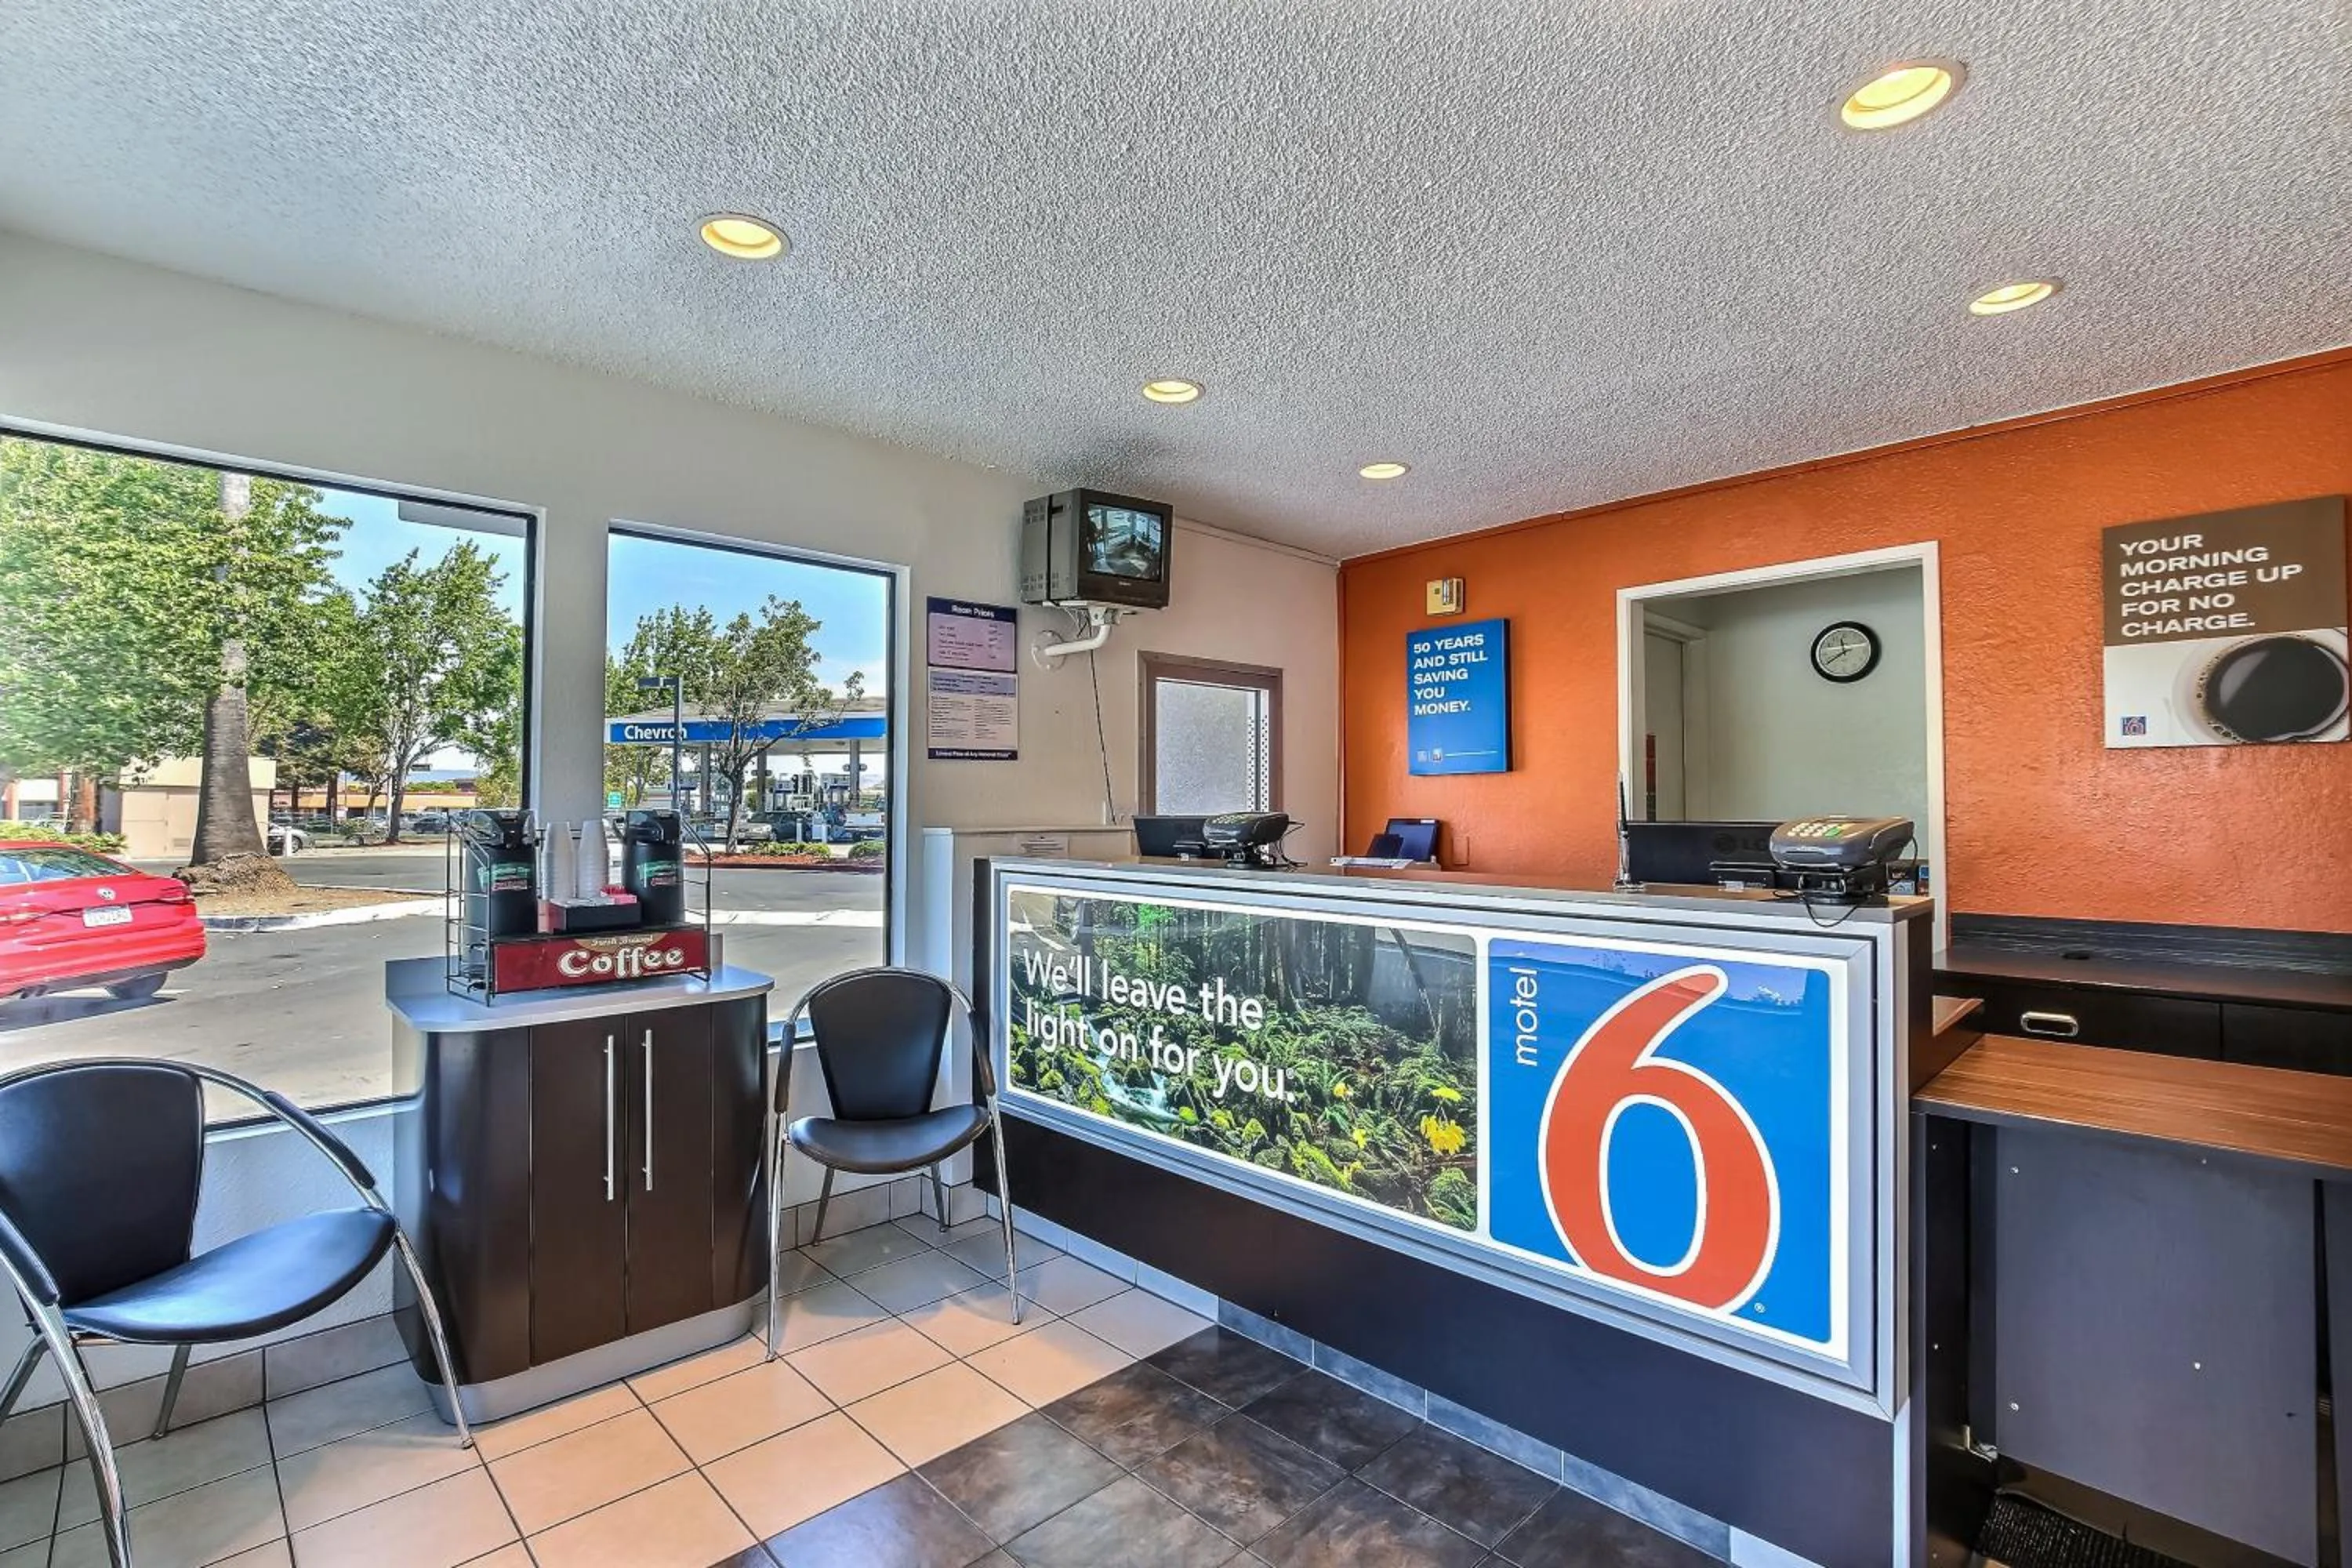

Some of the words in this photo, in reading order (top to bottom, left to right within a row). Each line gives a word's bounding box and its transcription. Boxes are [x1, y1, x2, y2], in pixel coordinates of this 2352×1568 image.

[2120, 534, 2202, 557] YOUR
[2121, 546, 2269, 577] MORNING
[2121, 571, 2248, 596] CHARGE
[2256, 564, 2303, 583] UP
[2122, 598, 2180, 616] FOR
[2189, 593, 2235, 610] NO
[2122, 613, 2256, 637] CHARGE.
[1414, 643, 1431, 654] 50
[1435, 633, 1484, 651] YEARS
[1414, 655, 1445, 670] AND
[1450, 650, 1488, 665] STILL
[1414, 668, 1468, 684] SAVING
[1414, 687, 1445, 700] YOU
[1414, 701, 1471, 716] MONEY.
[557, 947, 684, 978] Coffee
[1023, 948, 1091, 996] We'll
[1102, 960, 1187, 1015] leave
[1199, 976, 1264, 1031] the
[1509, 967, 1537, 1067] motel
[1026, 996, 1089, 1053] light
[1099, 1028, 1138, 1062] on
[1149, 1025, 1200, 1076] for
[1538, 964, 1780, 1316] 6
